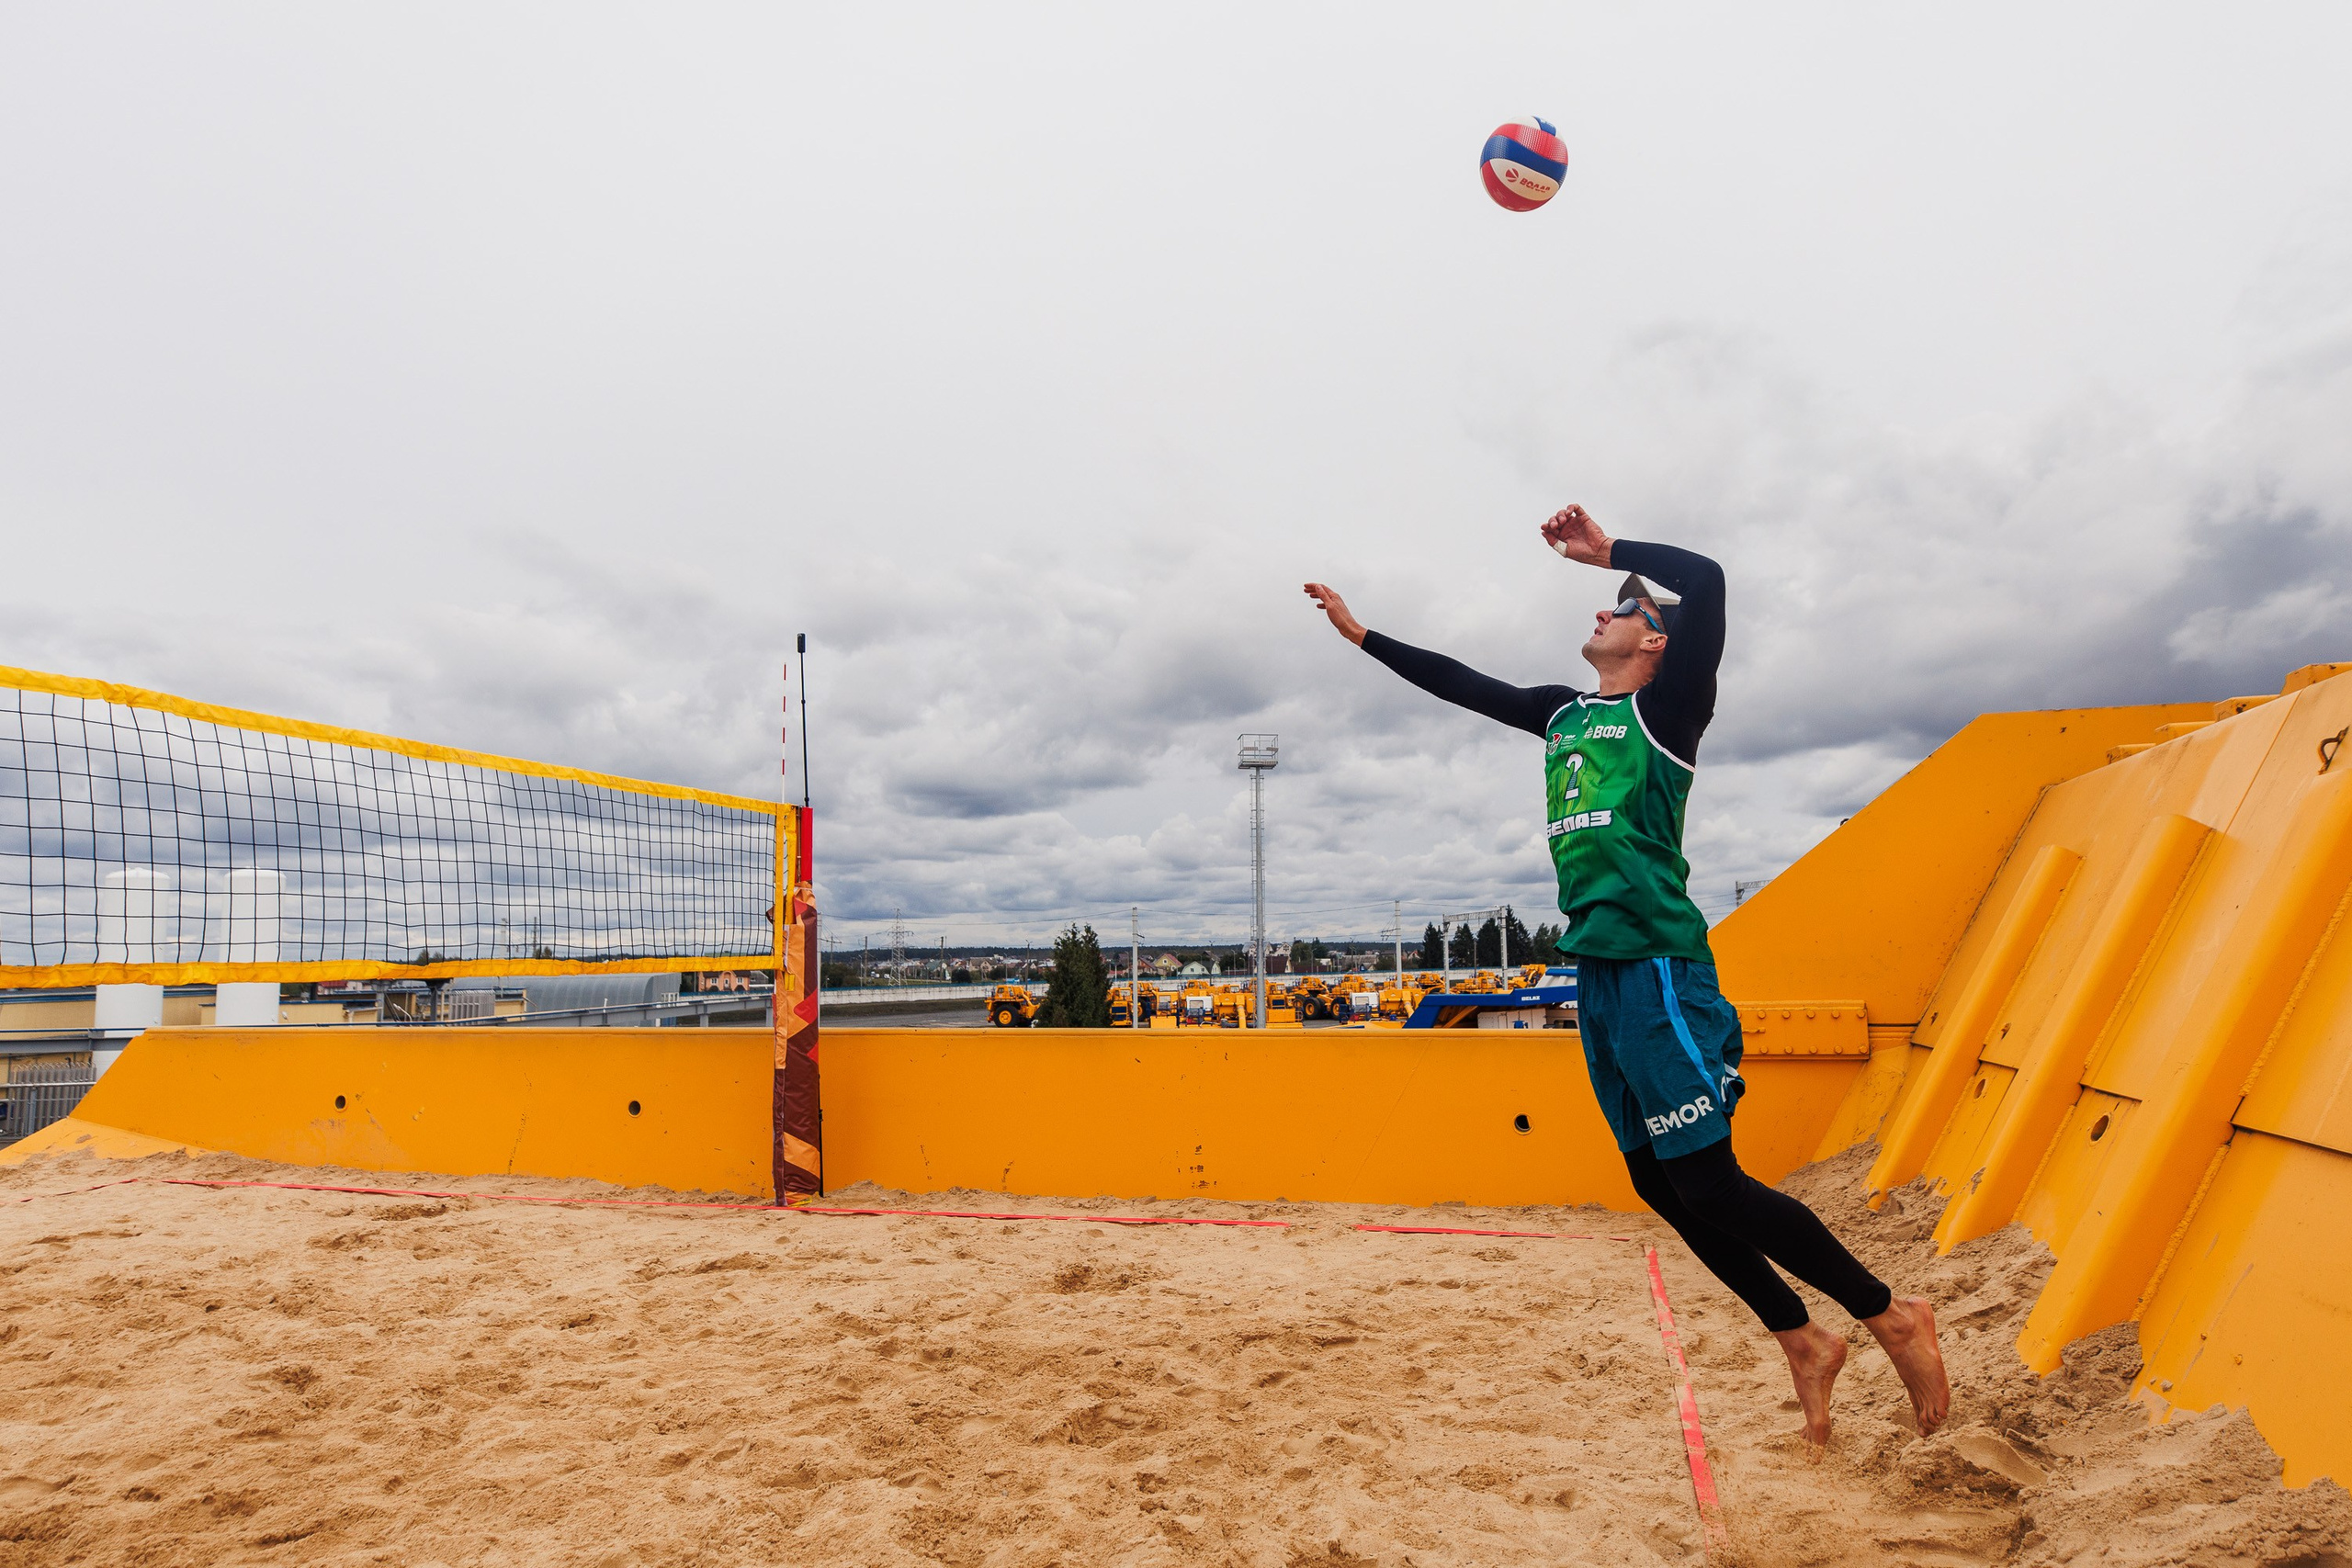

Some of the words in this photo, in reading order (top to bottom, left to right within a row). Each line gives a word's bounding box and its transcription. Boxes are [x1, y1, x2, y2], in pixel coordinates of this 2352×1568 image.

[1592, 725, 1628, 739] ВФВ
[1566, 753, 1584, 800] 2
[1645, 1095, 1714, 1136] EMOR
